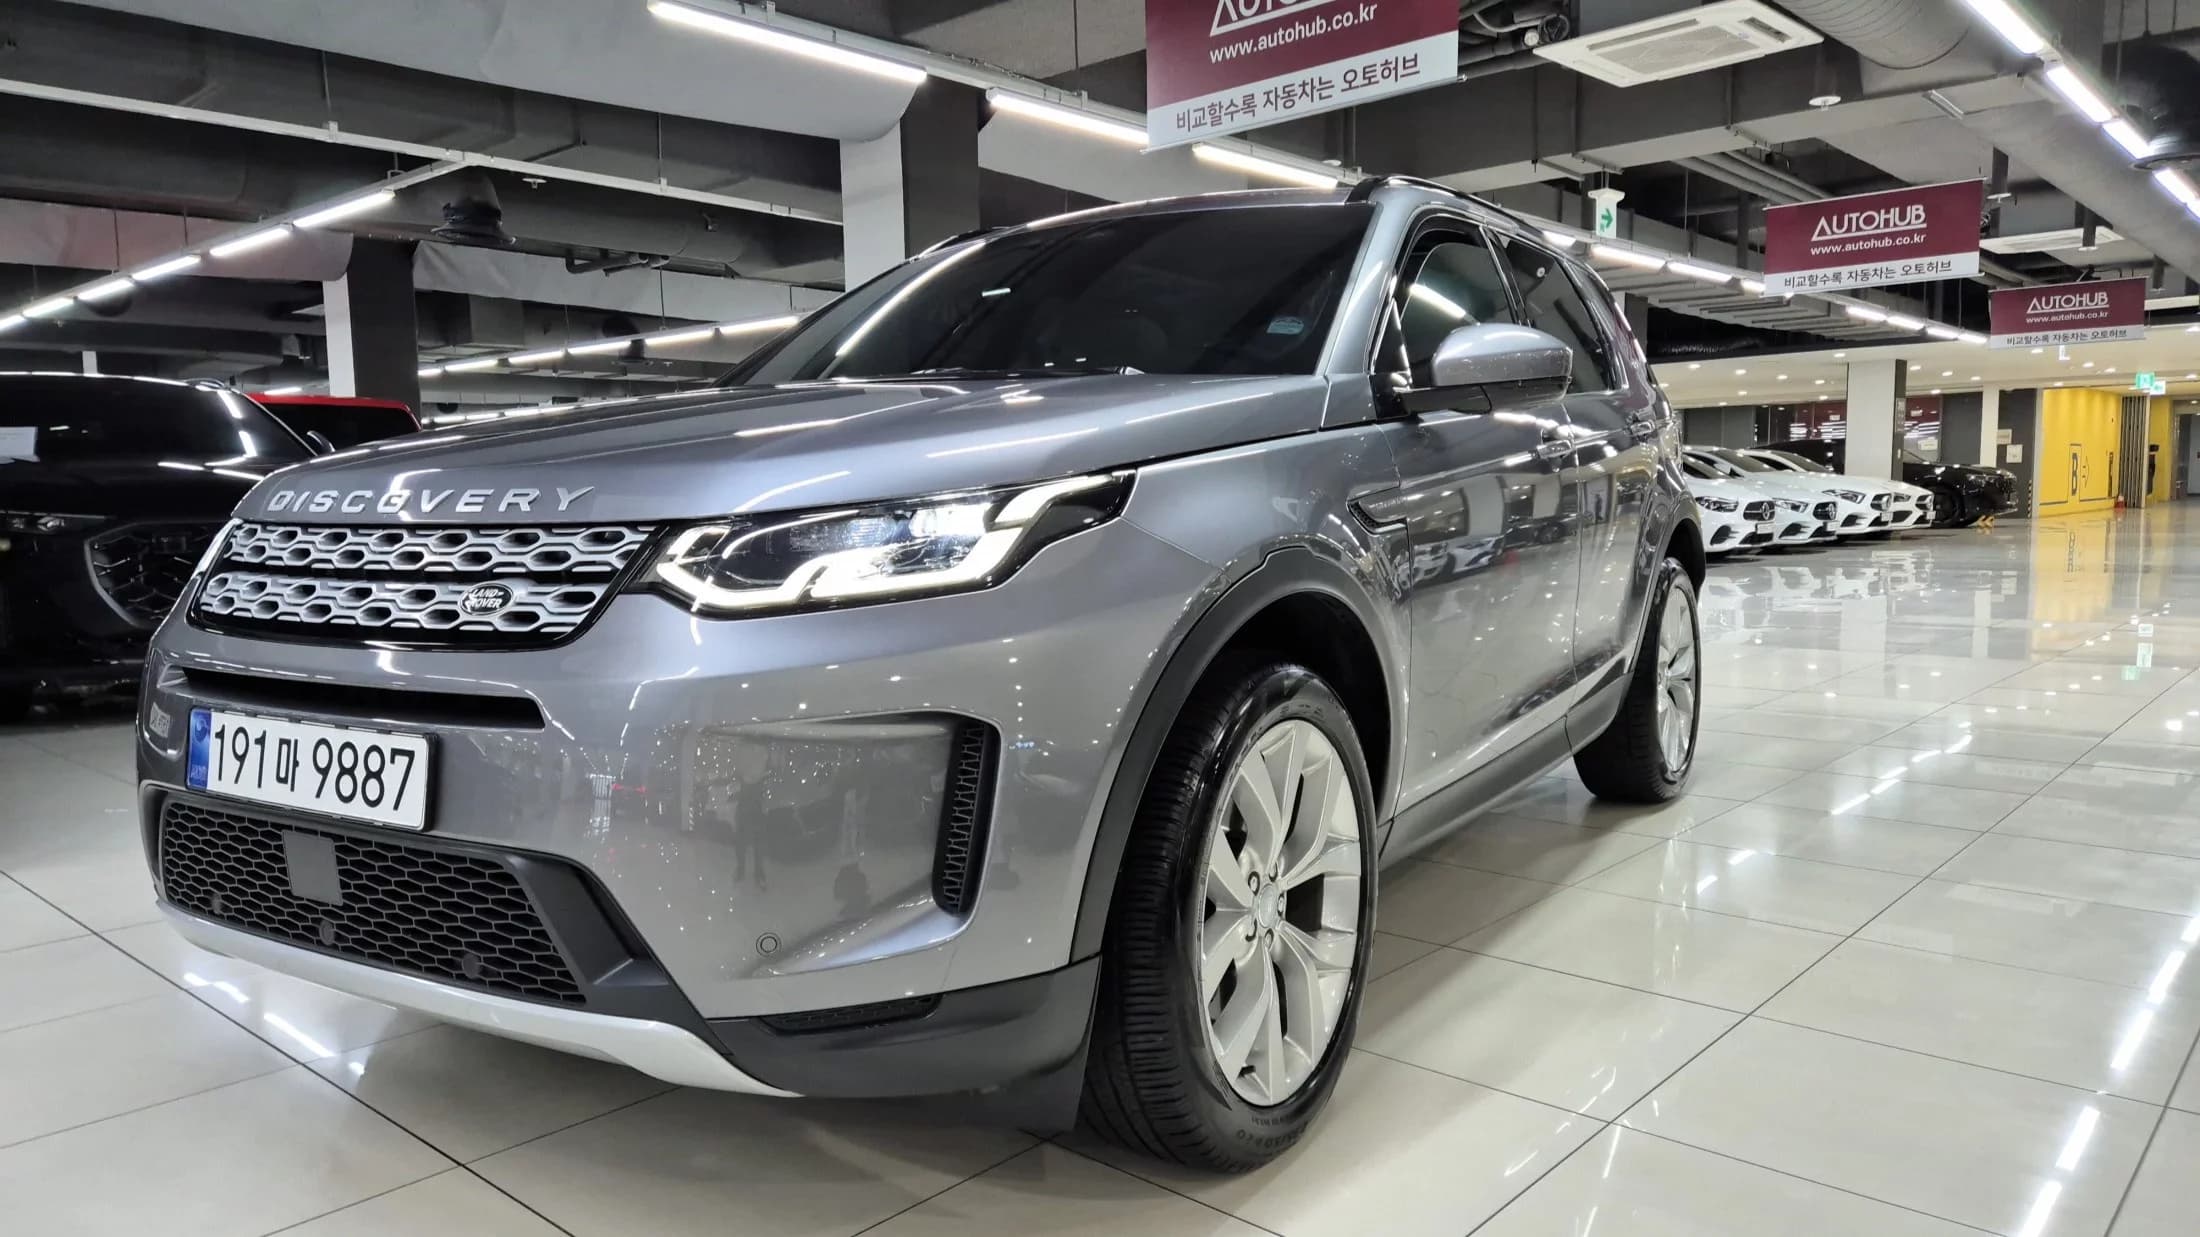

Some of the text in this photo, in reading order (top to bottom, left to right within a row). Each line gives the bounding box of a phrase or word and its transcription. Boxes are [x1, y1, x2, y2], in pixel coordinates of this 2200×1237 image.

[1210, 3, 1378, 64] www.autohub.co.kr
[1176, 53, 1421, 132] 비교할수록 자동차는 오토허브
[1811, 204, 1927, 241] AUTOHUB
[1811, 233, 1927, 255] www.autohub.co.kr
[1784, 260, 1952, 288] 비교할수록 자동차는 오토허브
[2027, 291, 2110, 314] AUTOHUB
[267, 486, 595, 513] DISCOVERY
[214, 724, 415, 811] 191마 9887
